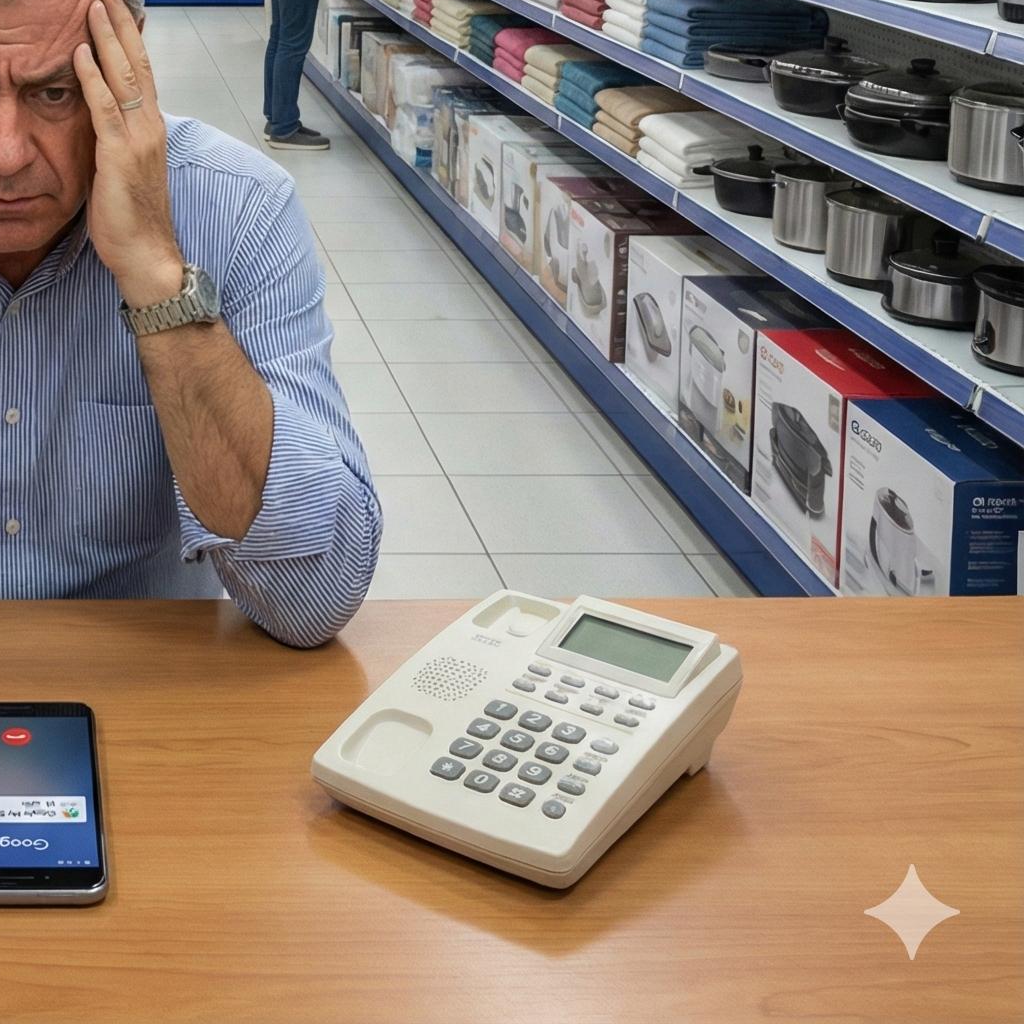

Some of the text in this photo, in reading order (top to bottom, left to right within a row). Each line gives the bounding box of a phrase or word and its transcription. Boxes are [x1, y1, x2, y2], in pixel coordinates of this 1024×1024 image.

[526, 713, 542, 724] 2
[561, 725, 577, 736] 3
[509, 733, 525, 744] 5
[544, 745, 560, 756] 6
[458, 740, 475, 751] 7
[526, 766, 542, 777] 9
